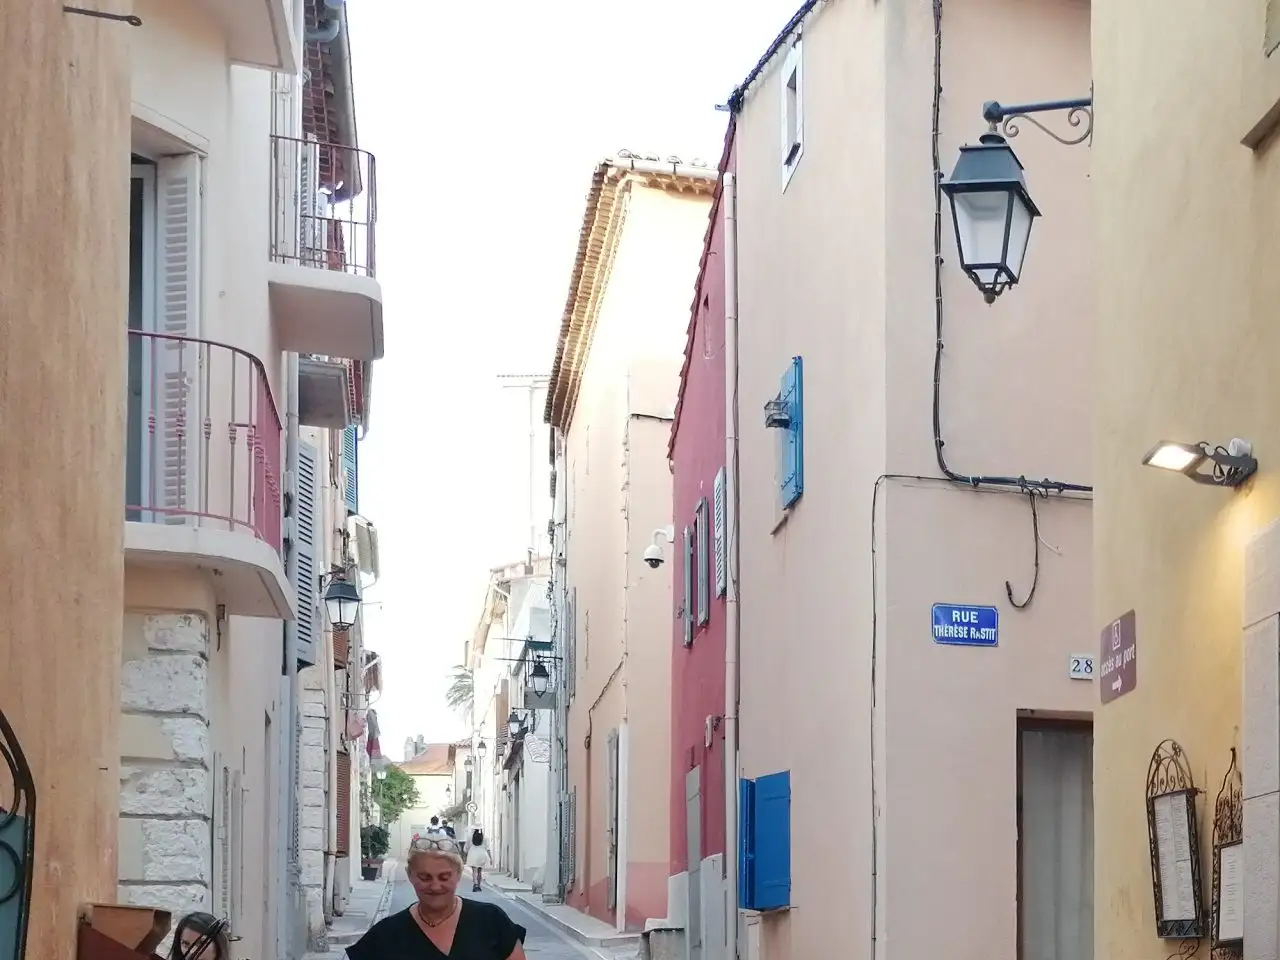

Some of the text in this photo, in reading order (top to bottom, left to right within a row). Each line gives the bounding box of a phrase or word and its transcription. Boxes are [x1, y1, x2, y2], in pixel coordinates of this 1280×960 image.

[952, 610, 979, 624] RUE
[934, 624, 968, 639] THÉRÈSE
[1072, 659, 1093, 674] 28
[1101, 644, 1135, 677] accès au port
